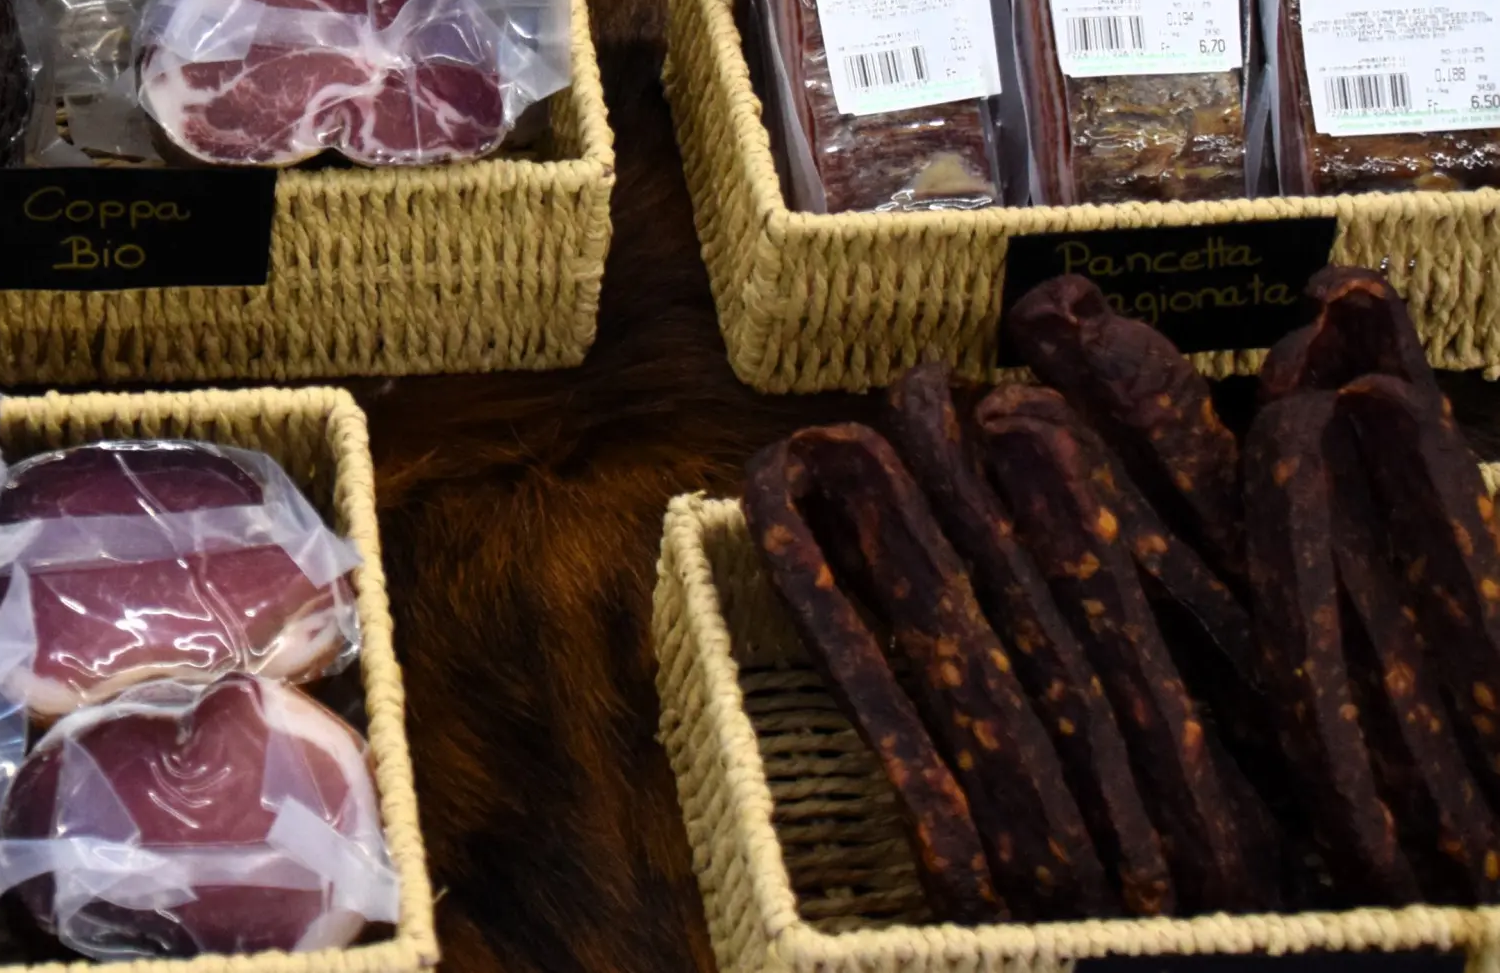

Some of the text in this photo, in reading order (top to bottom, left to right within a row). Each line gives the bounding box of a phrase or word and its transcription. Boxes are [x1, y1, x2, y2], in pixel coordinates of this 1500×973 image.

[1199, 38, 1226, 54] 6.70
[1434, 67, 1466, 83] 0.188
[1470, 94, 1500, 110] 6.50
[23, 186, 192, 230] Coppa
[52, 235, 147, 270] Bio
[1054, 237, 1263, 278] Pancetta
[1105, 274, 1298, 326] agionata
